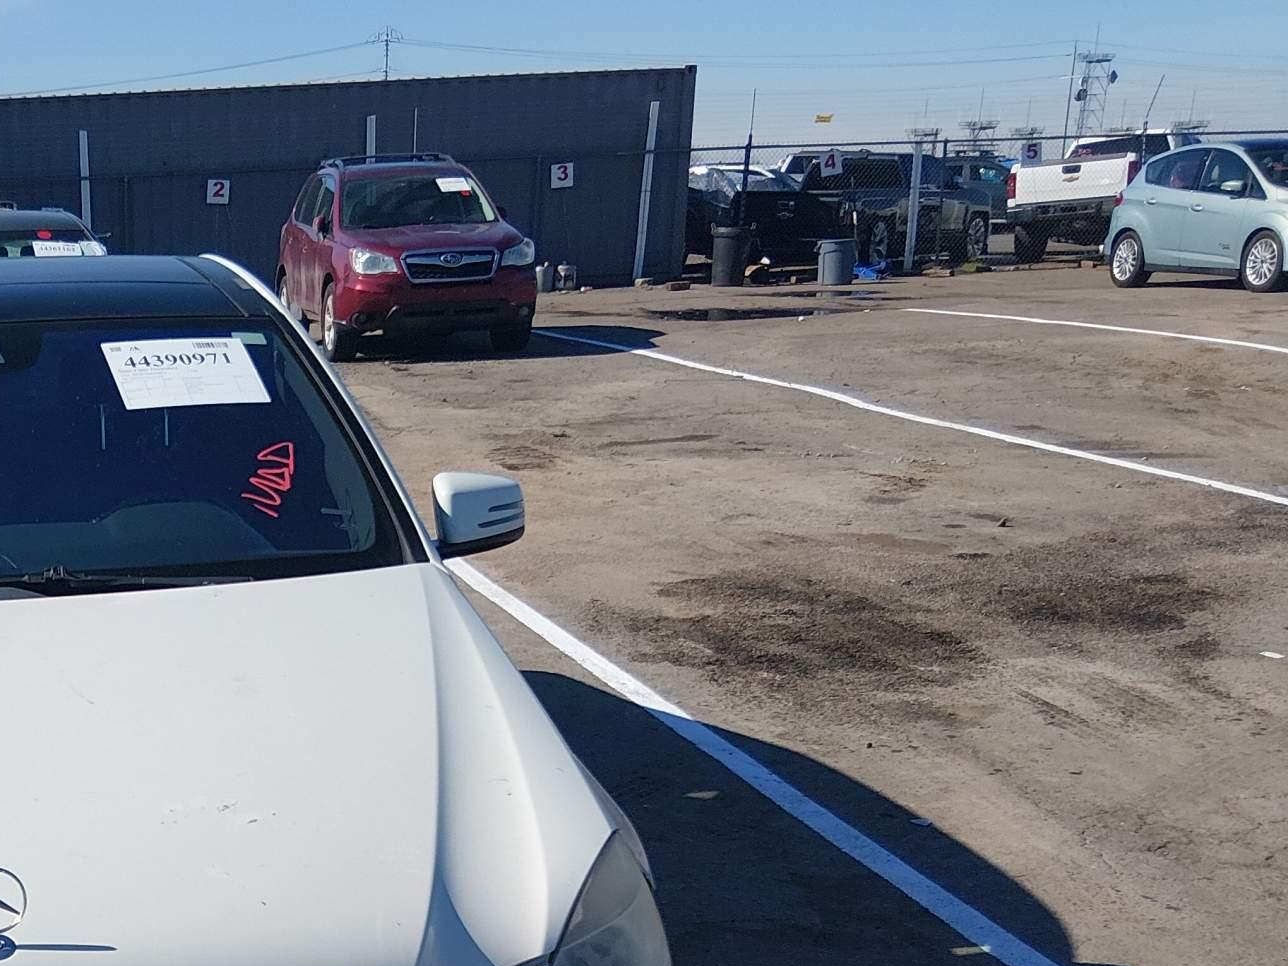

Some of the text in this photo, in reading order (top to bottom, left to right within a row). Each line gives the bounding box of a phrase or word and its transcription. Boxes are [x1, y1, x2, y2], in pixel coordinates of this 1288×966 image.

[1026, 143, 1038, 160] 5
[824, 153, 836, 169] 4
[556, 164, 569, 181] 3
[212, 181, 225, 198] 2
[123, 352, 232, 368] 44390971
